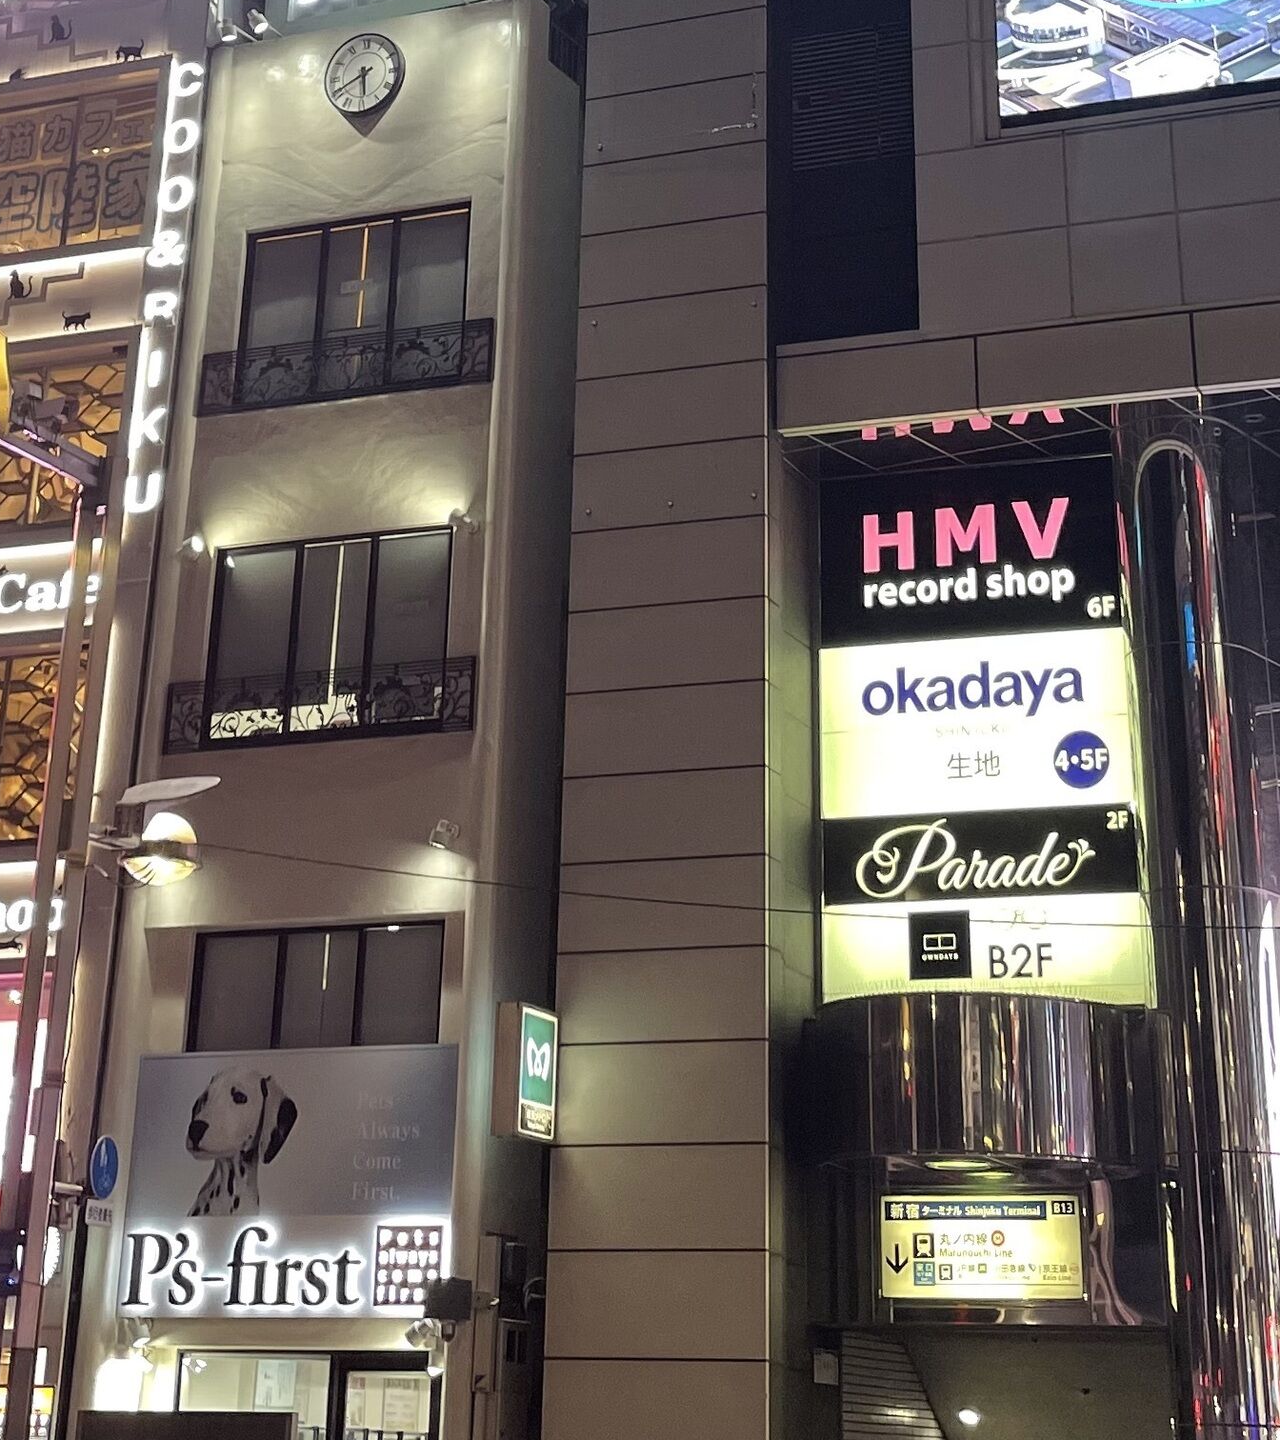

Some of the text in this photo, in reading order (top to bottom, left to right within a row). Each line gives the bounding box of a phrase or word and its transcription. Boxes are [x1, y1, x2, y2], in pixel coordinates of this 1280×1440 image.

[123, 59, 206, 515] COO & RIKU
[861, 496, 1070, 575] HMV
[863, 563, 1077, 609] record shop
[1087, 594, 1116, 619] 6F
[861, 661, 1085, 717] okadaya
[946, 749, 1002, 780] 生地
[1106, 810, 1128, 830] 2F
[855, 817, 1097, 898] Parade
[988, 942, 1053, 979] B2F
[964, 1203, 1003, 1218] Shinjuku
[1003, 1203, 1042, 1217] Terminal
[1052, 1201, 1074, 1215] B13
[121, 1224, 363, 1308] P's-first
